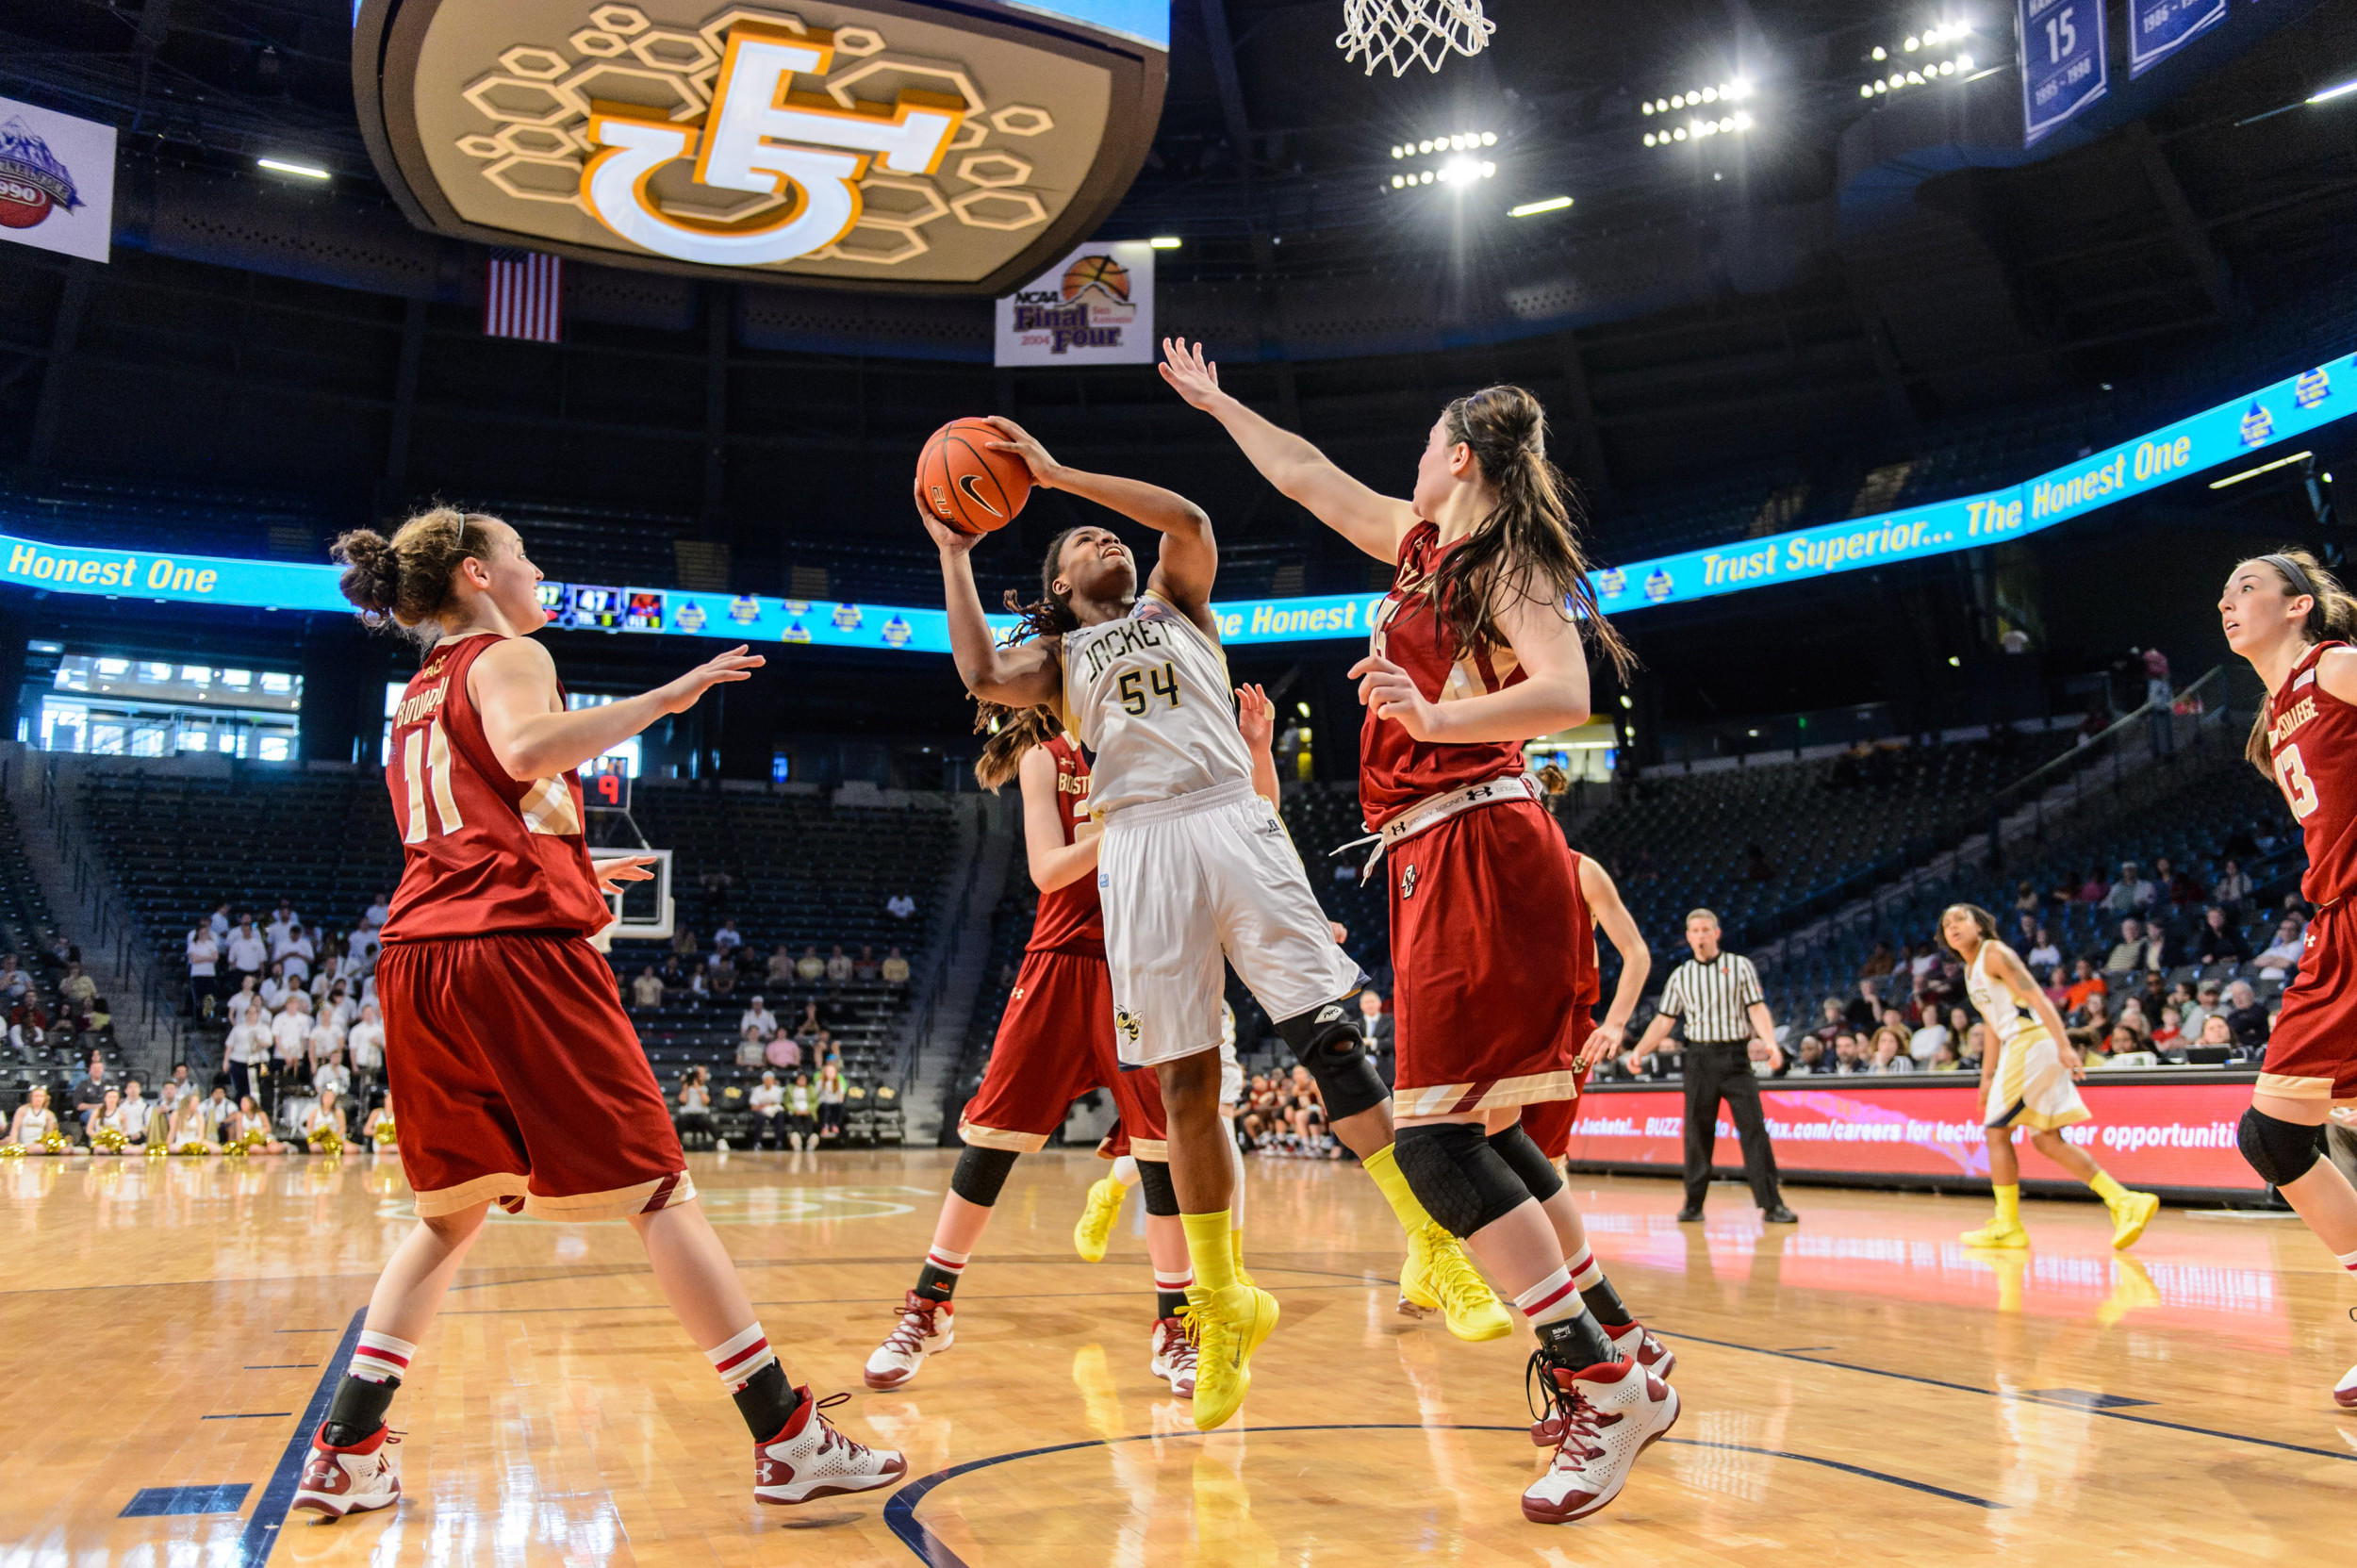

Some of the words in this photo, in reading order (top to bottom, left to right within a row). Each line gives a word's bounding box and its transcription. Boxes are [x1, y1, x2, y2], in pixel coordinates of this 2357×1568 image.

[2046, 7, 2076, 64] 15
[0, 181, 36, 202] 990
[1015, 291, 1059, 304] NCAA
[1014, 305, 1089, 332] Final
[1051, 327, 1121, 354] Four
[1703, 544, 1778, 586] Trust
[1786, 520, 1953, 572] Superior...
[1967, 500, 2022, 536] The
[2032, 452, 2127, 520] Honest
[2134, 436, 2191, 483] One
[8, 544, 137, 586] Honest
[147, 559, 218, 593] One
[580, 589, 609, 612] 47
[1212, 610, 1244, 635] he
[1251, 602, 1357, 635] Honest
[1085, 619, 1181, 684] JACKET
[1118, 659, 1181, 718] 54
[2277, 695, 2319, 742] COLLEGE
[404, 716, 464, 844] 11
[599, 775, 619, 804] 9
[2274, 742, 2319, 825] 13
[1645, 1116, 1683, 1137] BUZZ
[1905, 1118, 1933, 1143] for
[2061, 1125, 2098, 1145] eer
[2102, 1122, 2238, 1152] opportuniti
